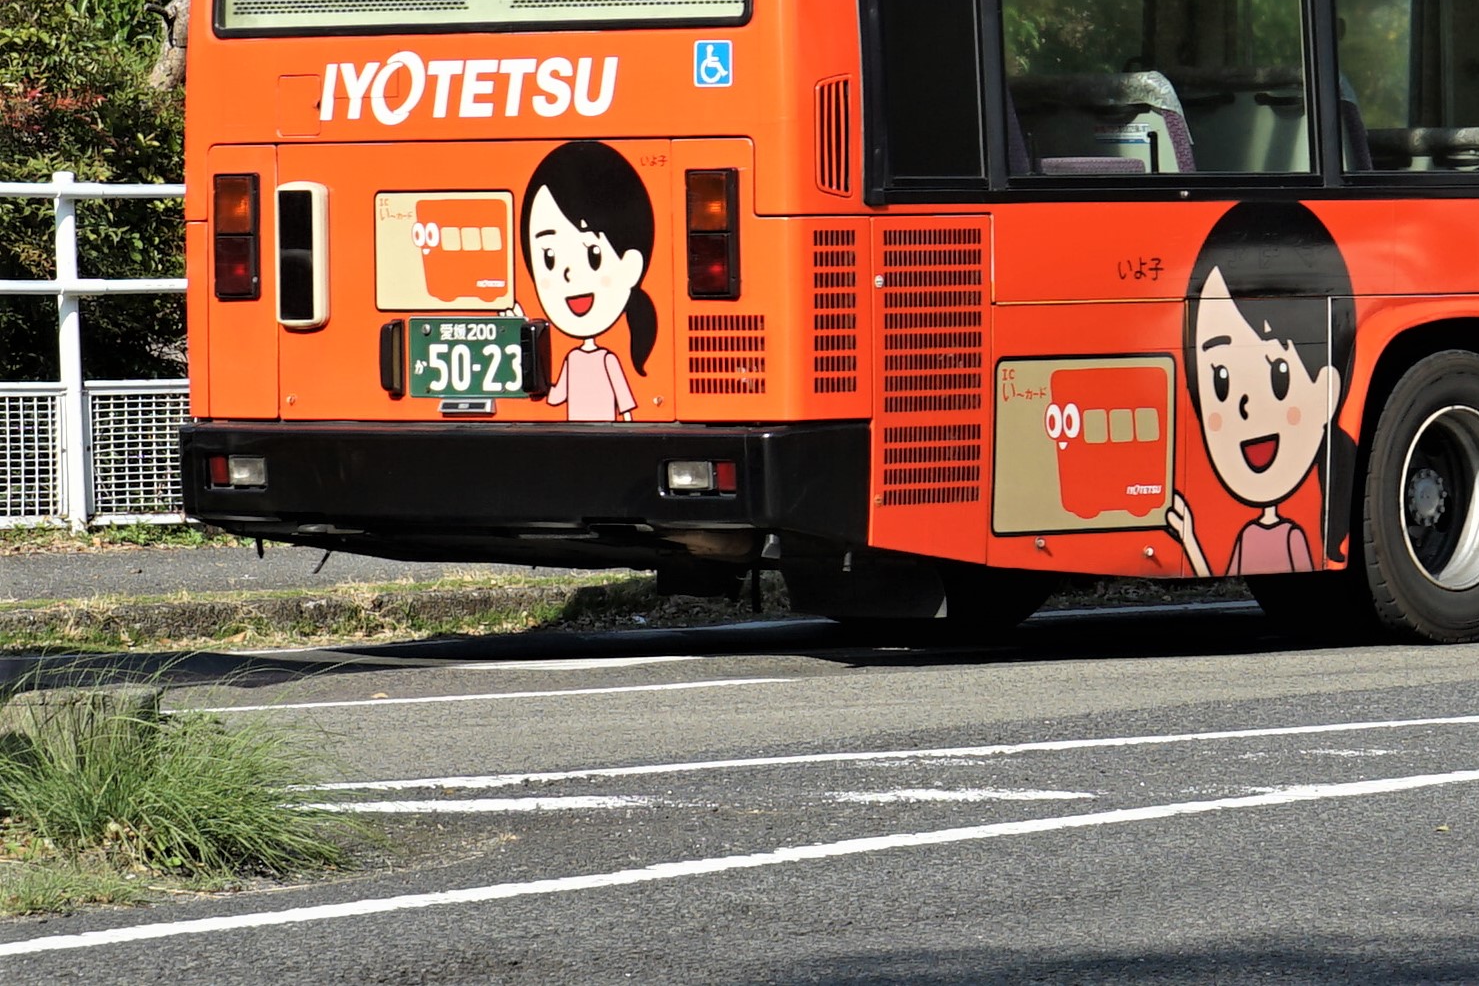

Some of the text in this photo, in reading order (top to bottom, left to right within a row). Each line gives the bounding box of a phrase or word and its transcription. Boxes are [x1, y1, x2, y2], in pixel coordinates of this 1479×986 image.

[319, 50, 618, 126] IYOTETSU
[1117, 257, 1164, 281] いよ子
[414, 344, 522, 391] か 50-23
[1002, 369, 1015, 381] IC
